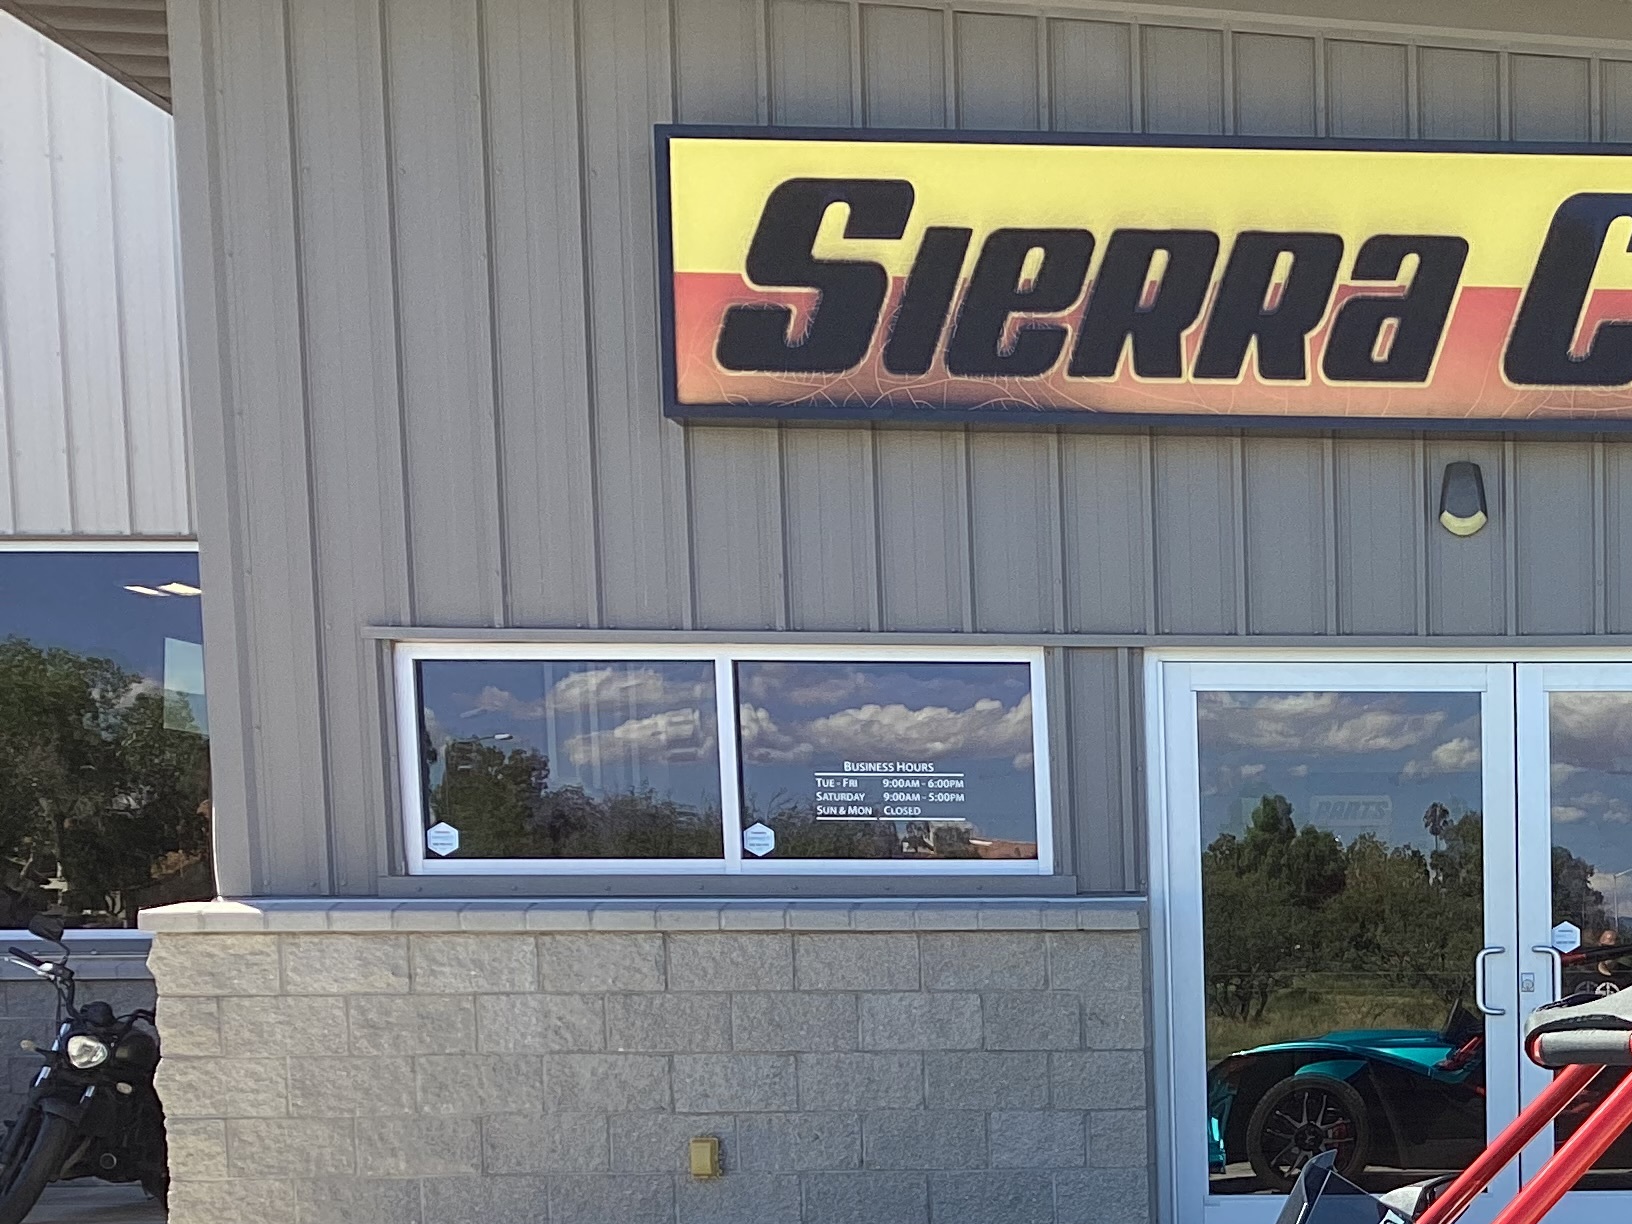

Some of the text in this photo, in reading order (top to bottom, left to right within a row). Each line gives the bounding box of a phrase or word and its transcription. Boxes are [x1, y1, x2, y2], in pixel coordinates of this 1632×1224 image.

[843, 761, 935, 772] BUSINESS HOURS
[815, 778, 835, 787] TUE
[842, 778, 858, 787] FRI
[882, 779, 920, 788] 9:00AM
[927, 779, 964, 788] 6:00PM
[815, 791, 866, 801] SATURDAY
[883, 792, 921, 801] 9:00AM
[928, 792, 965, 802] 5:00PM
[816, 806, 921, 815] SUN & MON CLOSED
